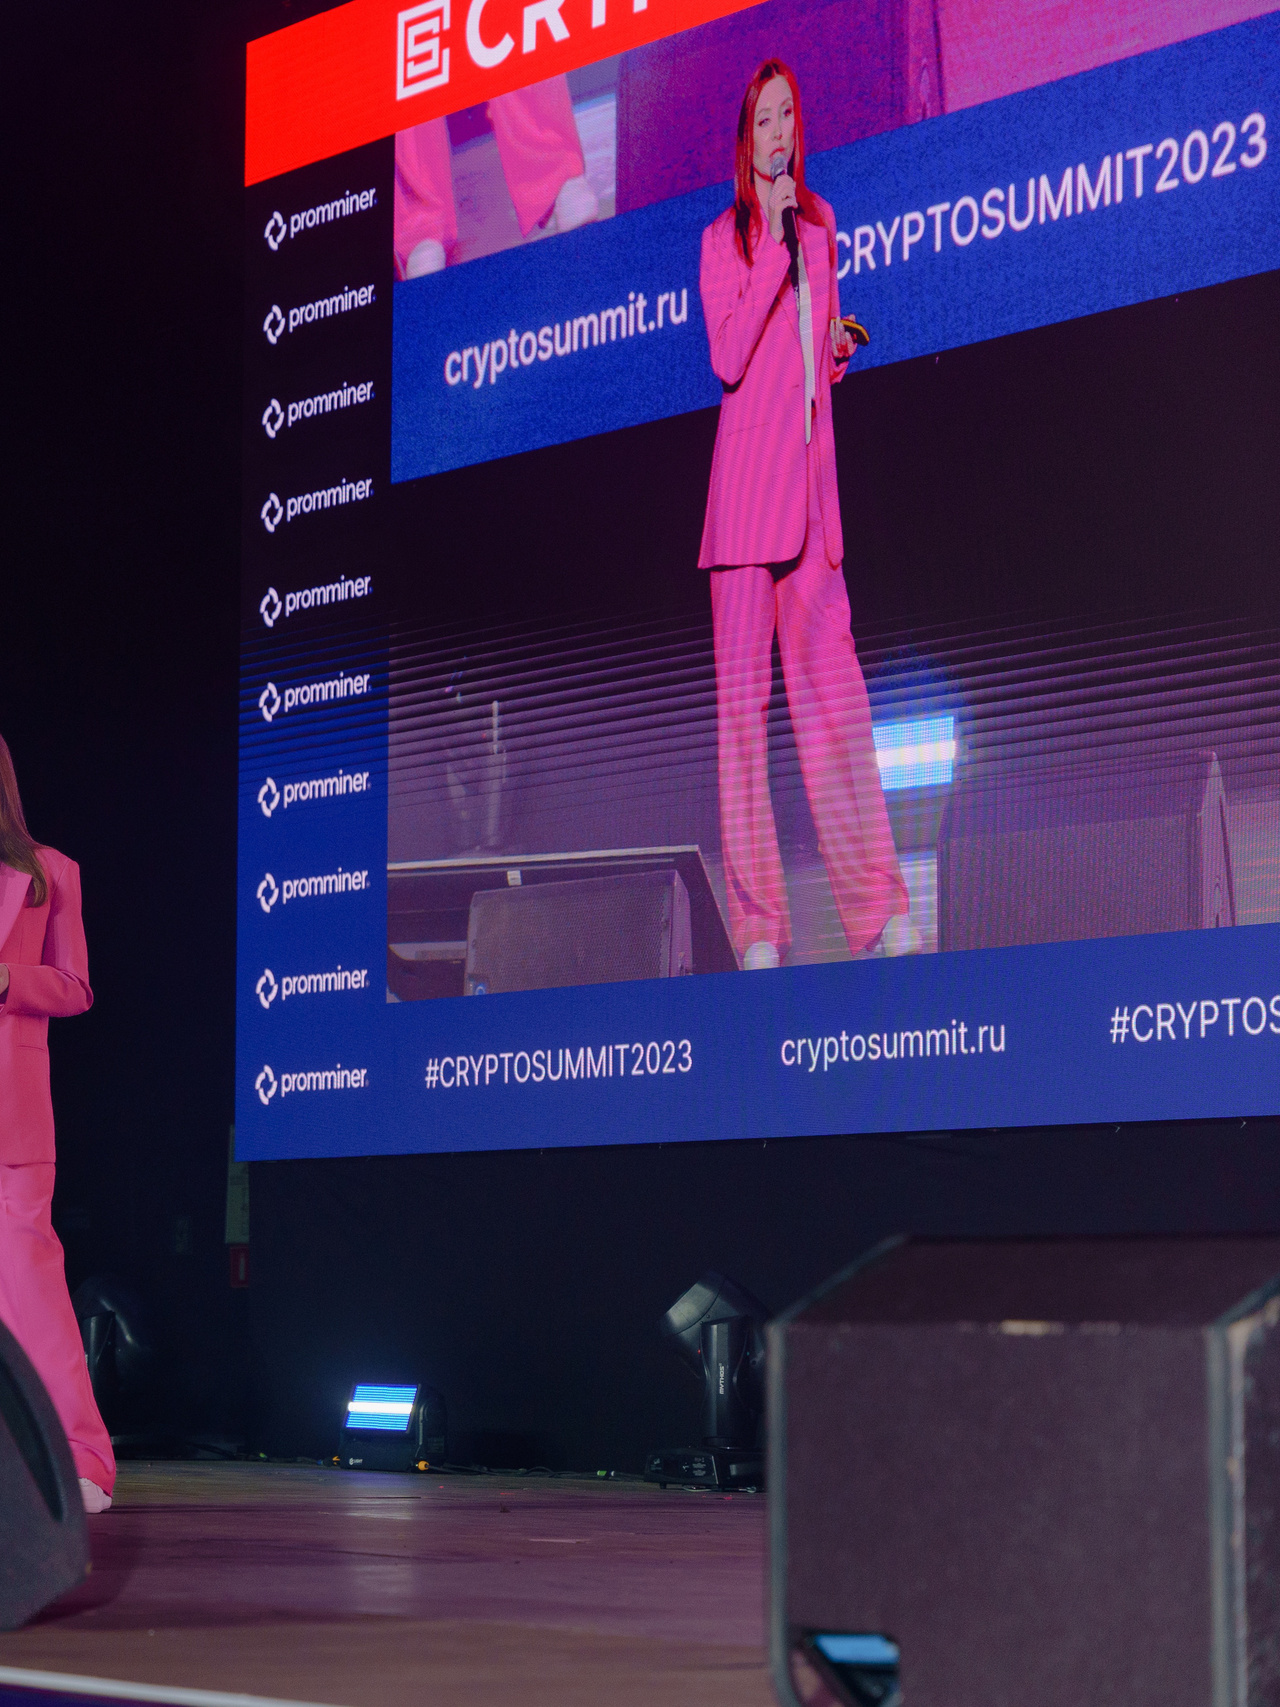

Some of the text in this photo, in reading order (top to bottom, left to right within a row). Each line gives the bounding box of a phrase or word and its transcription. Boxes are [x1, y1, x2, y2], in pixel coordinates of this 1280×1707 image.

[465, 0, 648, 69] CR
[290, 188, 376, 239] promminer
[289, 284, 375, 333] promminer
[444, 288, 689, 389] cryptosummit.ru
[287, 381, 374, 427] promminer
[286, 478, 373, 522] promminer
[285, 574, 371, 617] promminer
[284, 671, 370, 713] promminer
[283, 769, 370, 809] promminer
[282, 866, 369, 905] promminer
[281, 964, 368, 1001] promminer
[425, 1039, 693, 1089] #CRYPTOSUMMIT2023
[780, 1019, 1006, 1073] cryptosummit.ru
[280, 1063, 368, 1098] promminer
